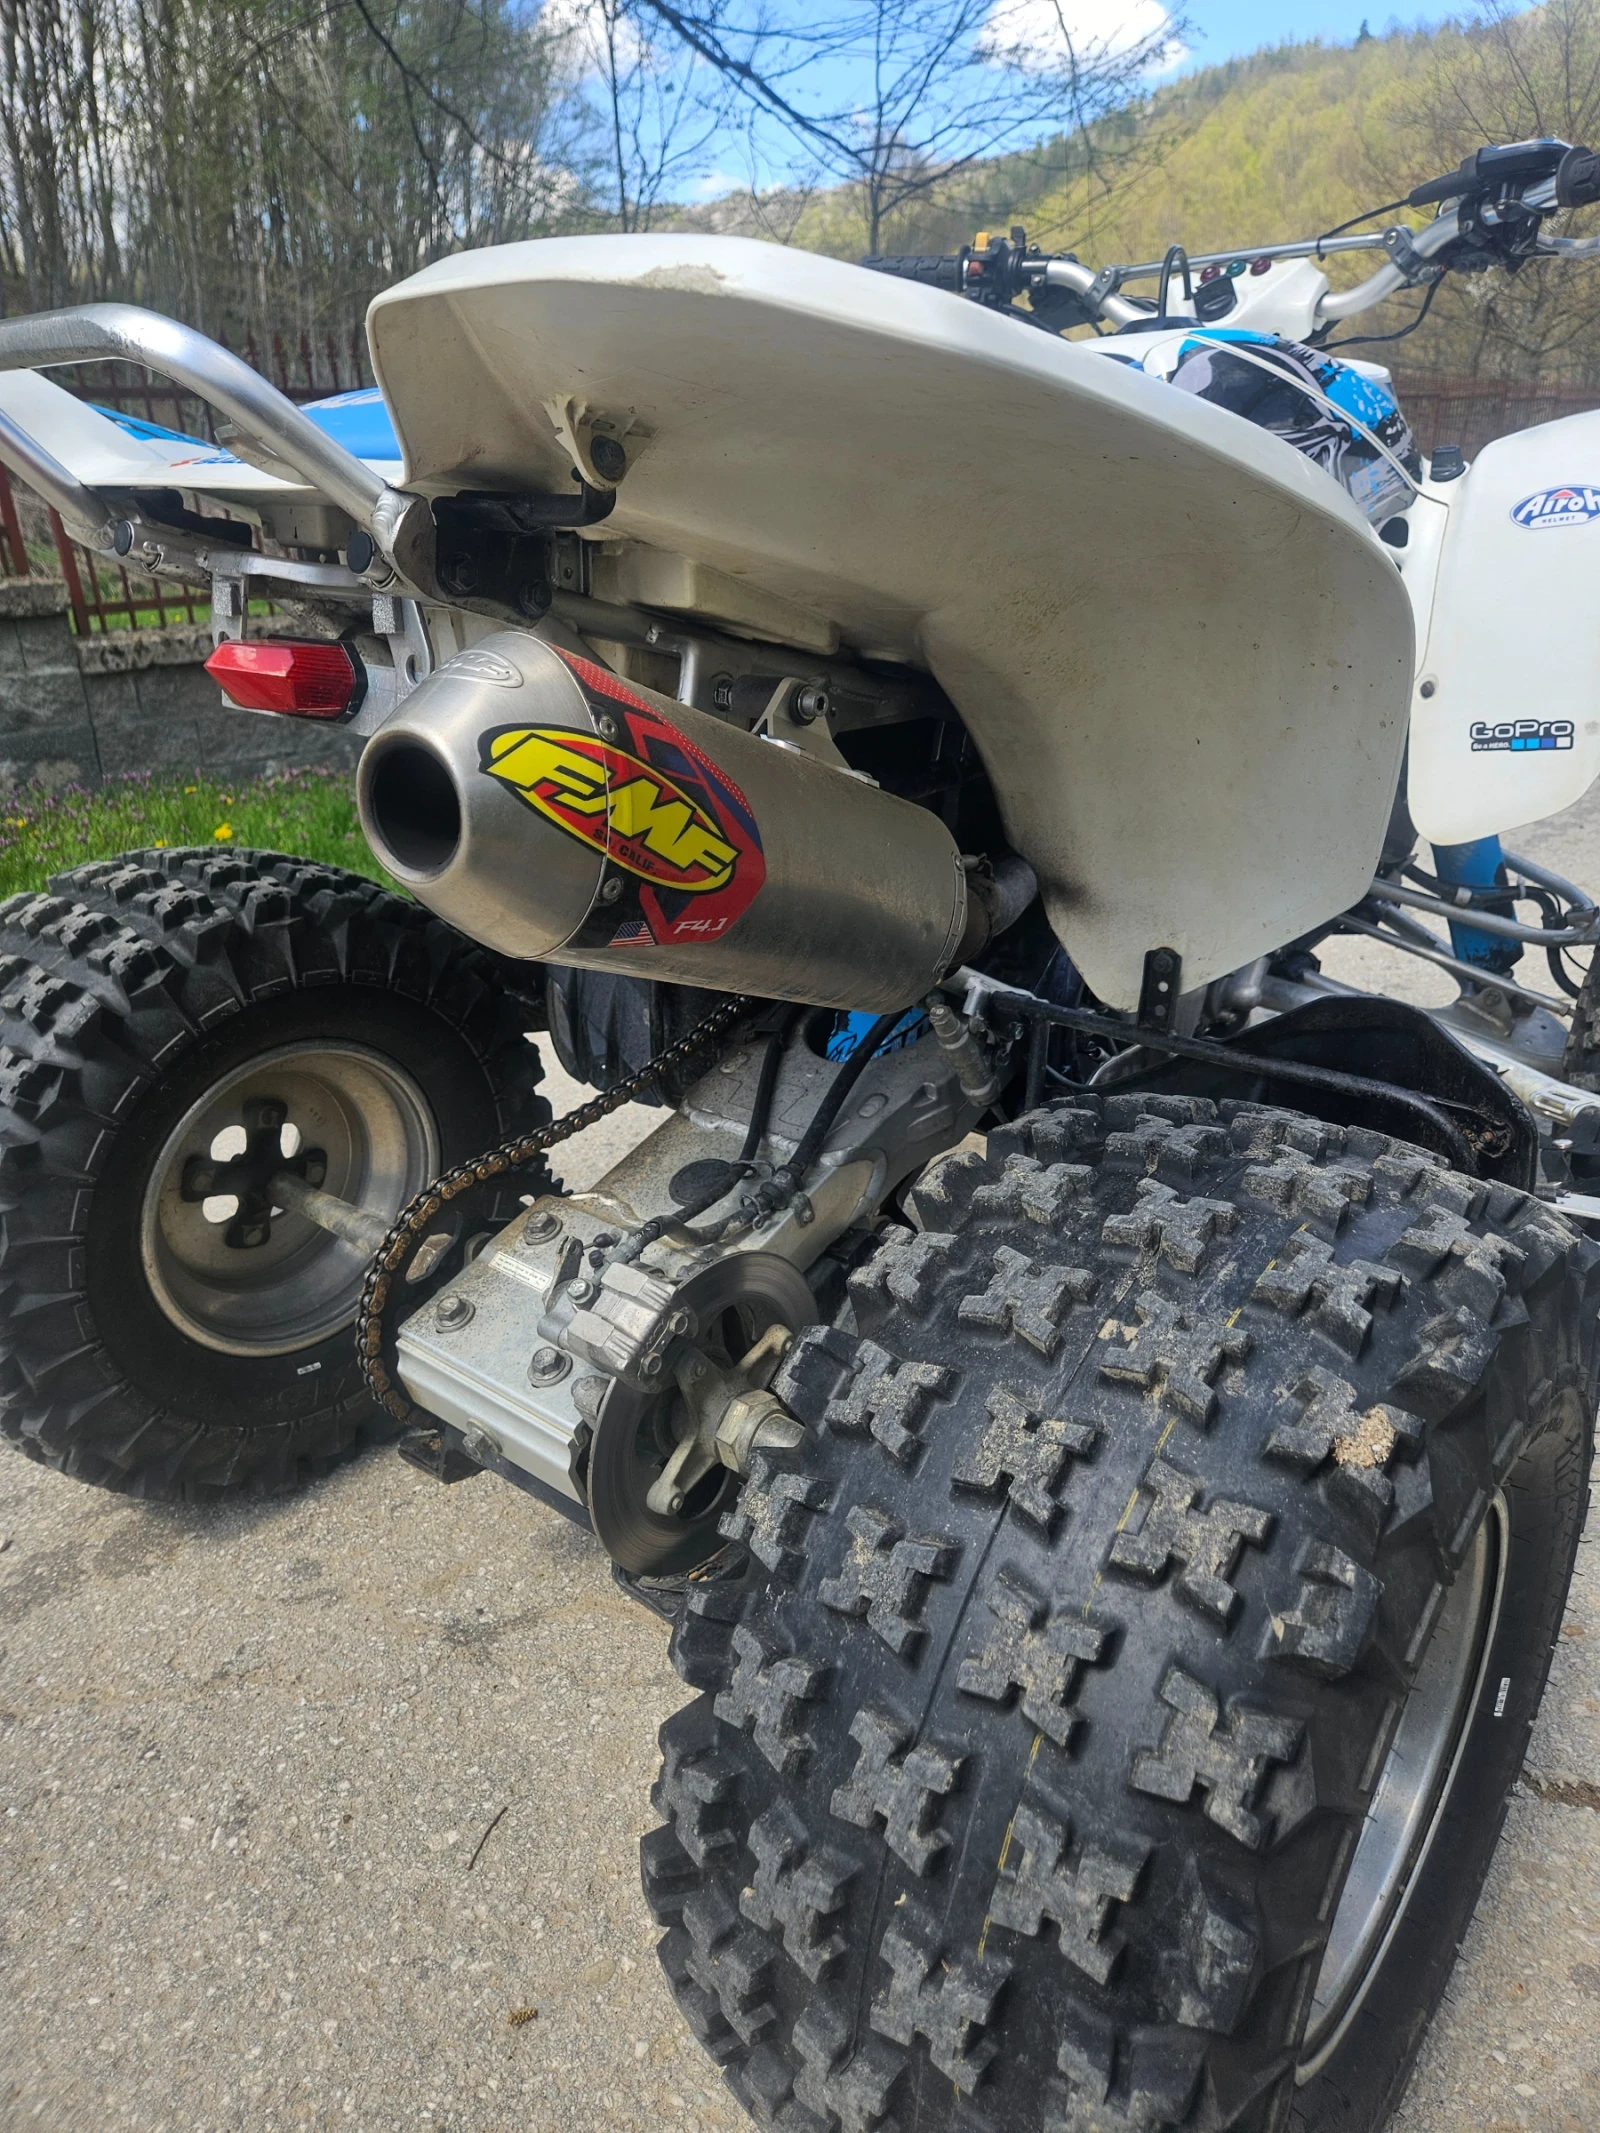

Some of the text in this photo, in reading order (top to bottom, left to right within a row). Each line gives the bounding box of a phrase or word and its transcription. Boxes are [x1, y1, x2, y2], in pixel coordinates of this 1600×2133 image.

[1515, 489, 1600, 522] Airoh
[1541, 515, 1576, 523] HELMET
[1471, 721, 1572, 739] GoPro
[484, 733, 743, 876] FMF
[673, 917, 728, 935] F4.1
